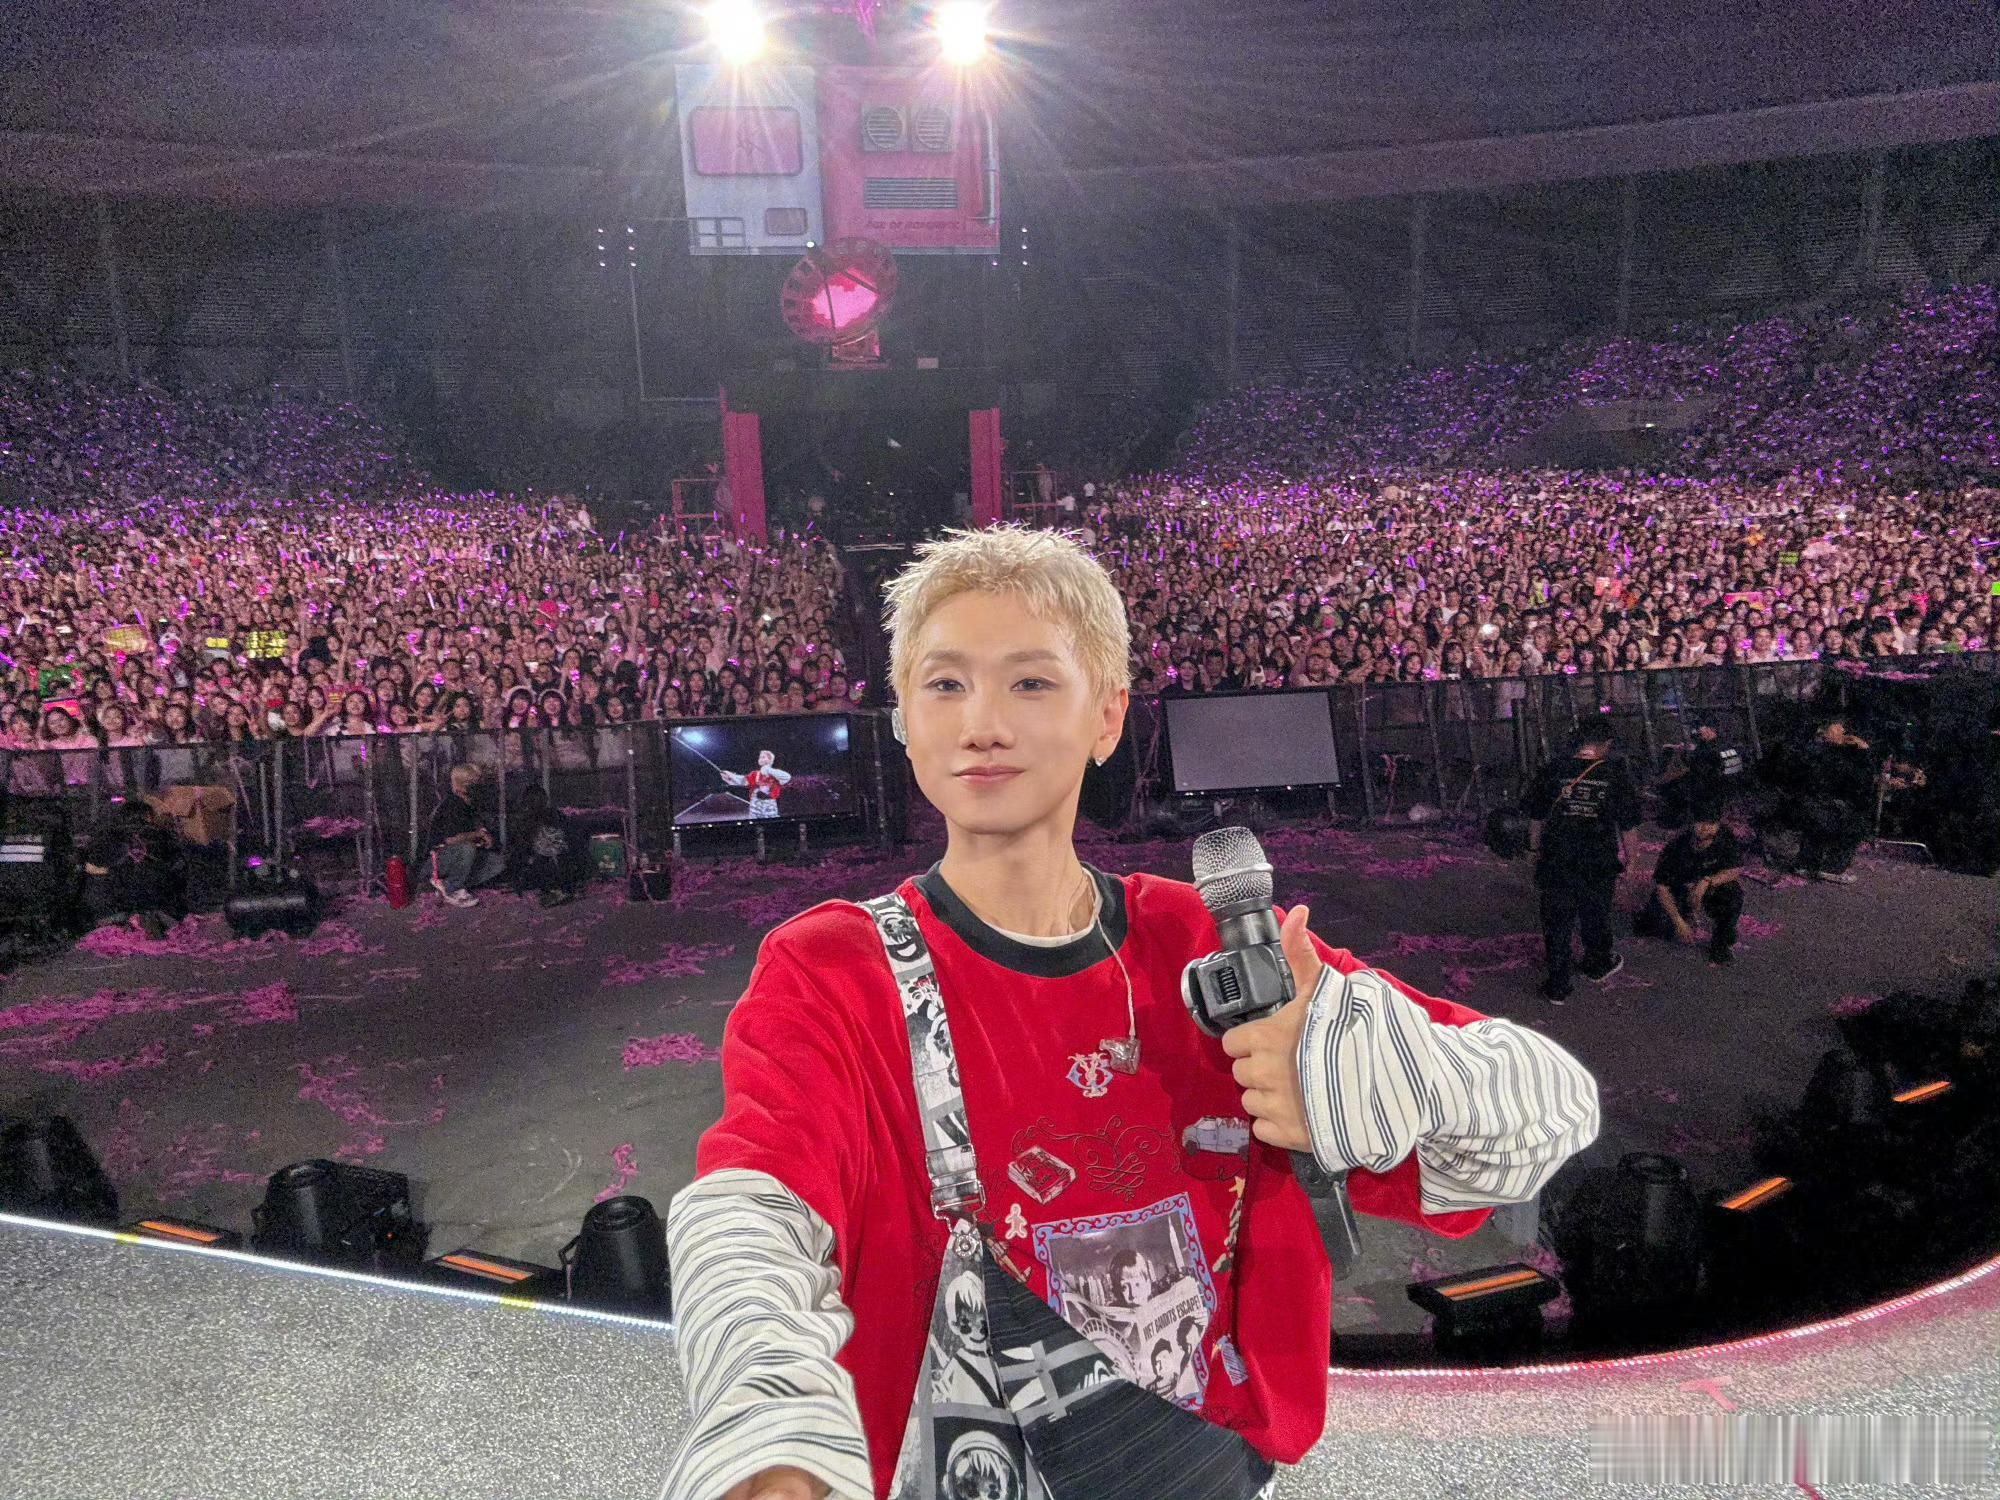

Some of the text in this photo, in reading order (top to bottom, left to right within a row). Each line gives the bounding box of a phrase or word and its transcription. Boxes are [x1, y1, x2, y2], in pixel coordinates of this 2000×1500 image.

[1143, 1295, 1202, 1341] WET BANDITS ESCAPE!
